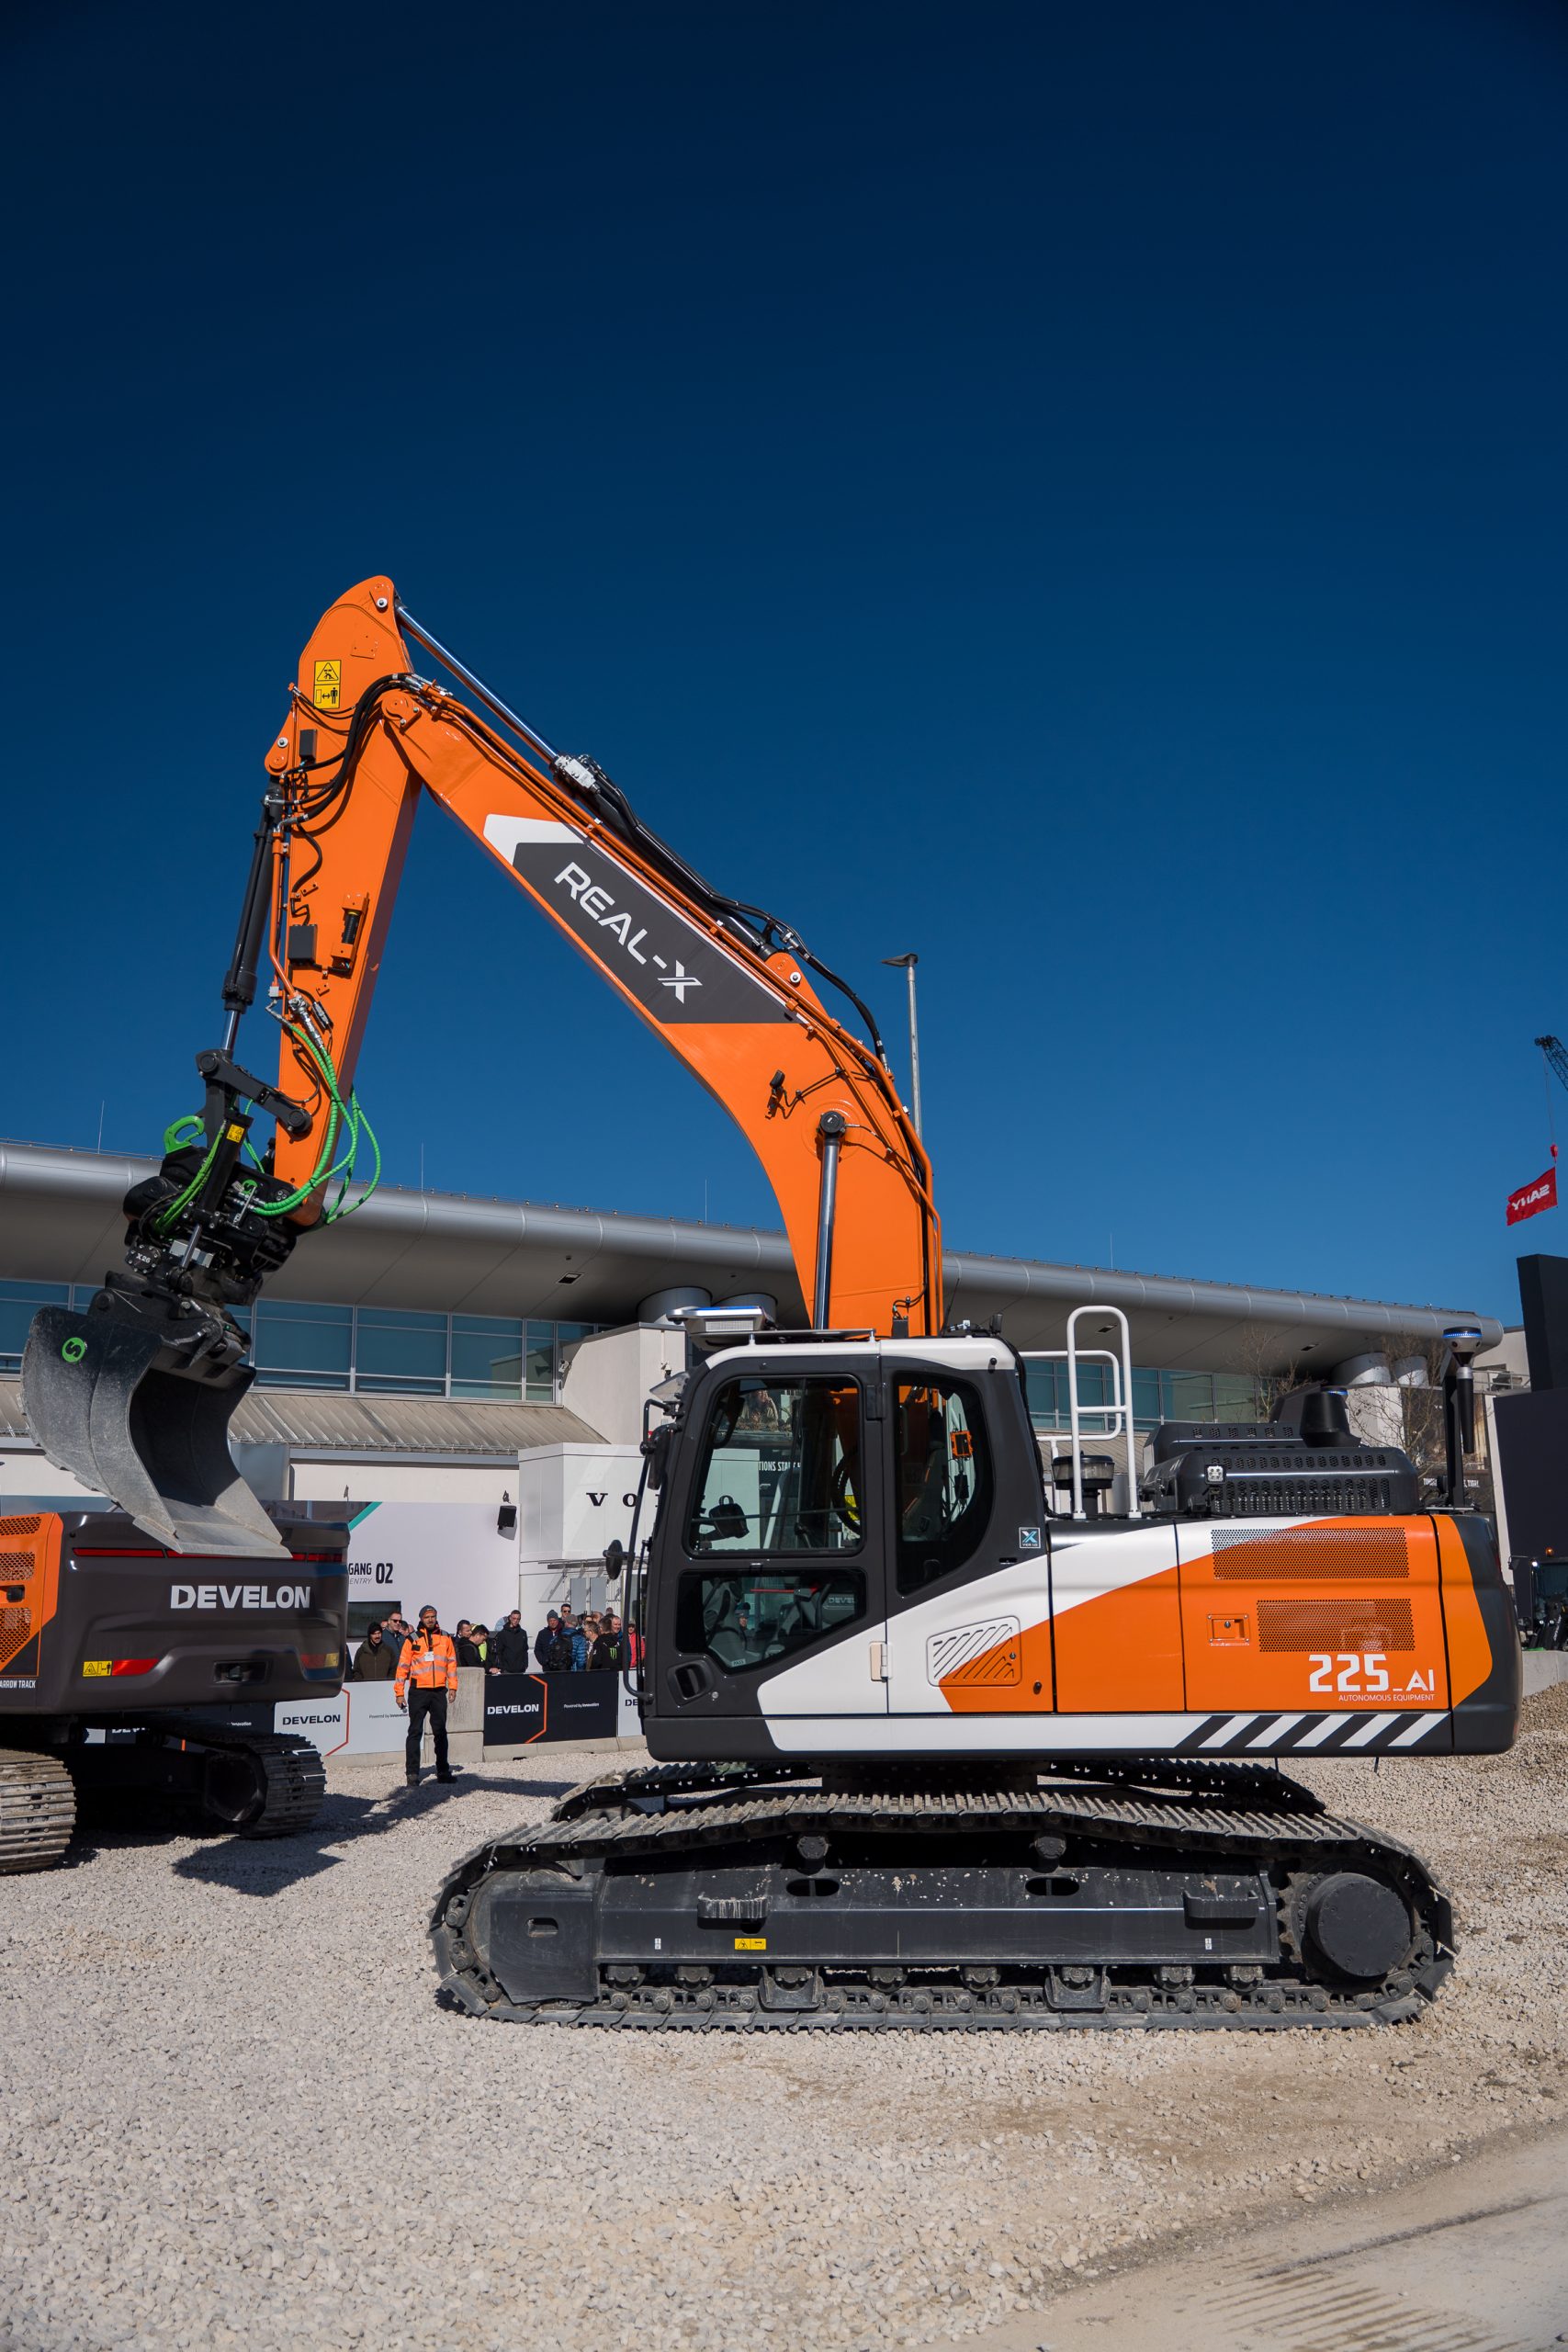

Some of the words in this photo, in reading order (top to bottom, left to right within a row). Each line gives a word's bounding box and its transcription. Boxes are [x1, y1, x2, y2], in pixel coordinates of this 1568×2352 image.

[554, 862, 703, 1004] REAL-X
[376, 1563, 393, 1584] 02
[170, 1585, 310, 1609] DEVELON
[18, 1680, 36, 1689] TRACK
[487, 1704, 539, 1714] DEVELON
[282, 1714, 341, 1724] DEVELON
